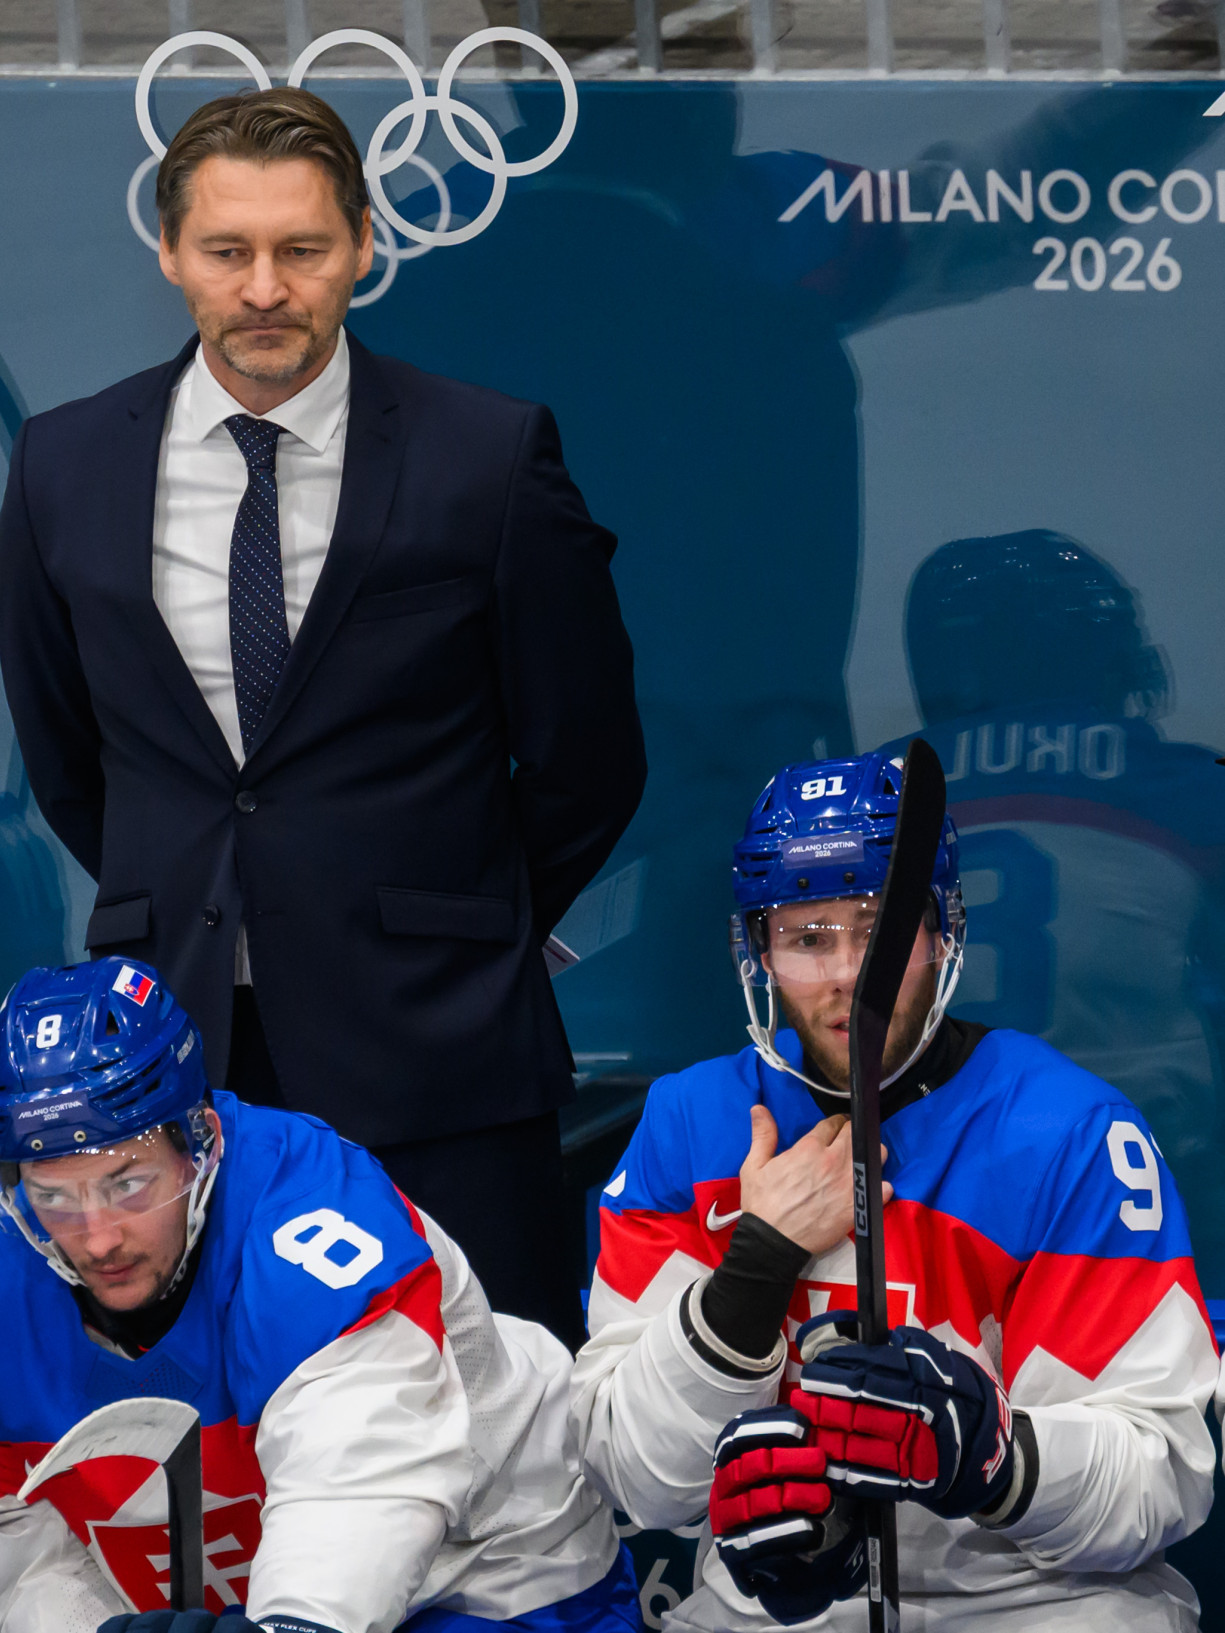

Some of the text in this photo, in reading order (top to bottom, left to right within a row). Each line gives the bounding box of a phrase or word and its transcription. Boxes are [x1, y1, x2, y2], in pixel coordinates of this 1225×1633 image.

[777, 169, 1225, 223] MILANO CO
[1032, 236, 1183, 291] 2026
[800, 775, 847, 801] 91
[788, 841, 857, 854] MILANO CORTINA
[35, 1014, 62, 1049] 8
[18, 1100, 83, 1120] MILANO CORTINA
[854, 1166, 867, 1232] CCM
[273, 1208, 384, 1290] 8
